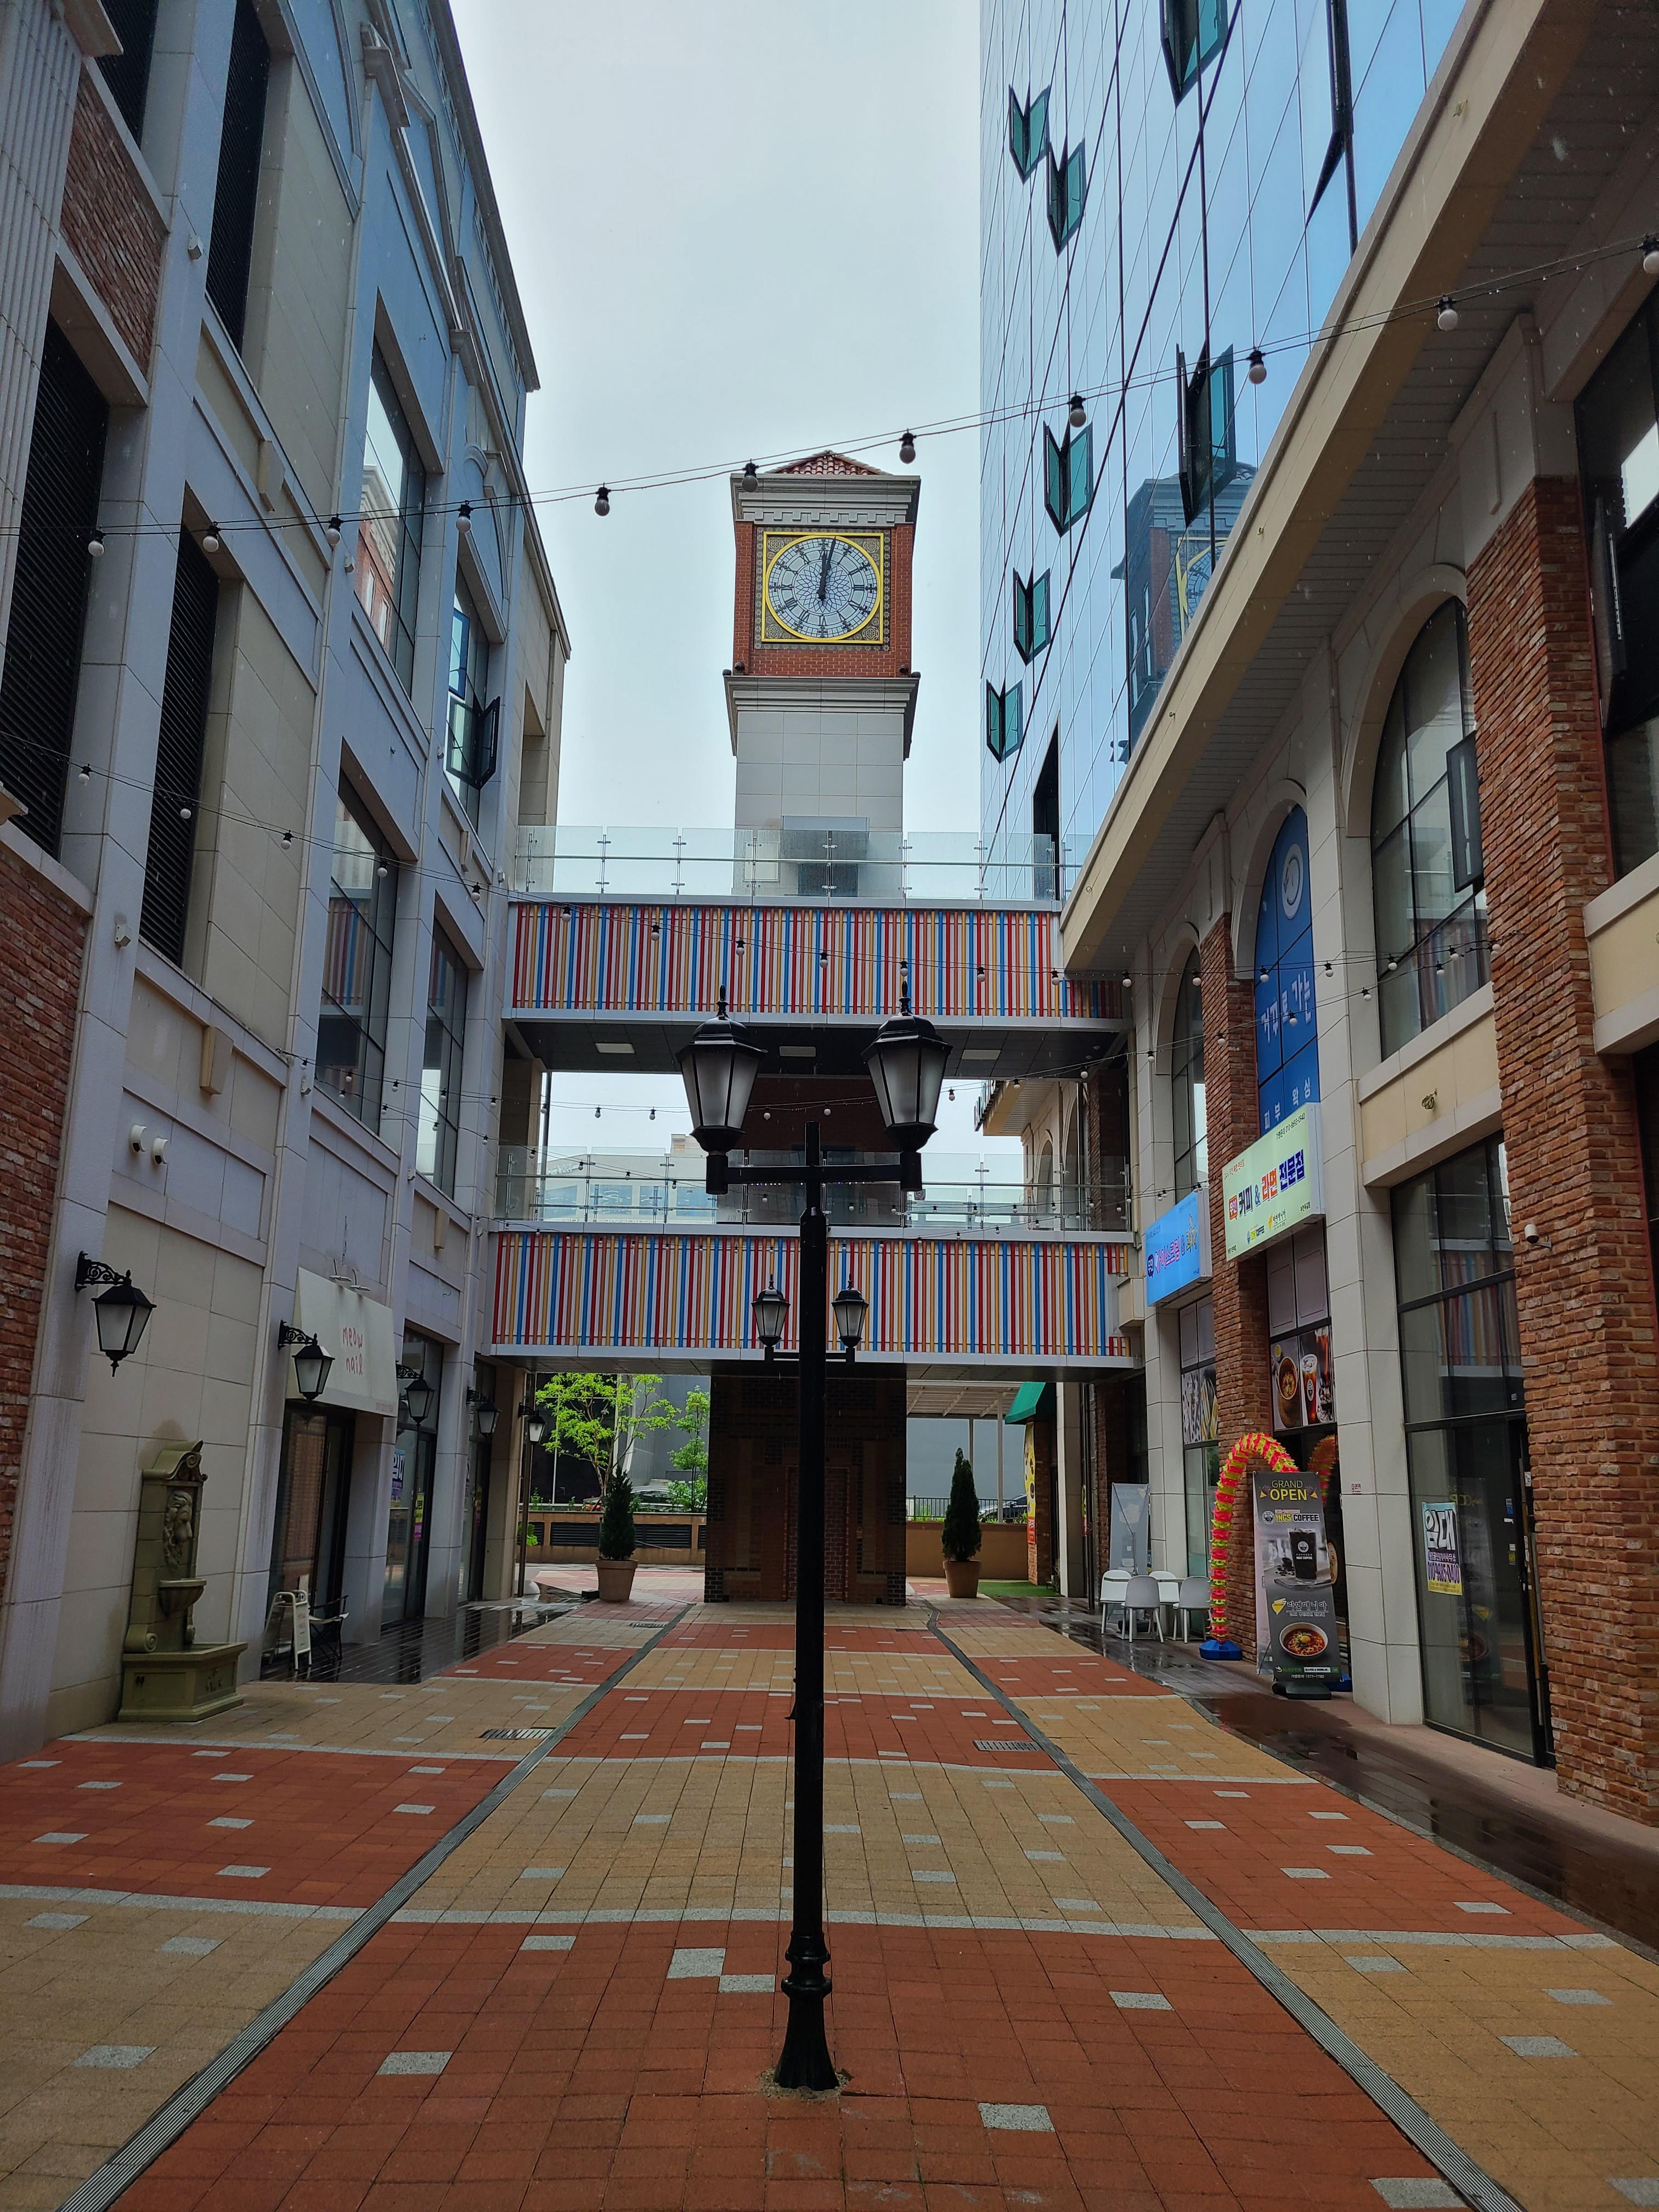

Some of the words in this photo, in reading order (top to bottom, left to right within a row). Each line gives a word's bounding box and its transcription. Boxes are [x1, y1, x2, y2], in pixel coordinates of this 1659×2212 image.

[1261, 989, 1289, 1045] 거꾸로
[1291, 969, 1312, 1024] 가는
[1264, 1102, 1281, 1130] 피부
[1292, 1076, 1311, 1106] 왁싱
[1238, 1185, 1253, 1216] 커피
[1254, 1184, 1261, 1206] &
[1261, 1168, 1278, 1201] 라면
[1279, 1149, 1306, 1192] 전문점
[342, 1327, 363, 1349] meow
[346, 1352, 363, 1376] nail
[1269, 1488, 1308, 1501] OPEN
[1272, 1480, 1303, 1488] GRAND
[1424, 1509, 1458, 1551] 임대
[1286, 1600, 1328, 1611] 라면매니아
